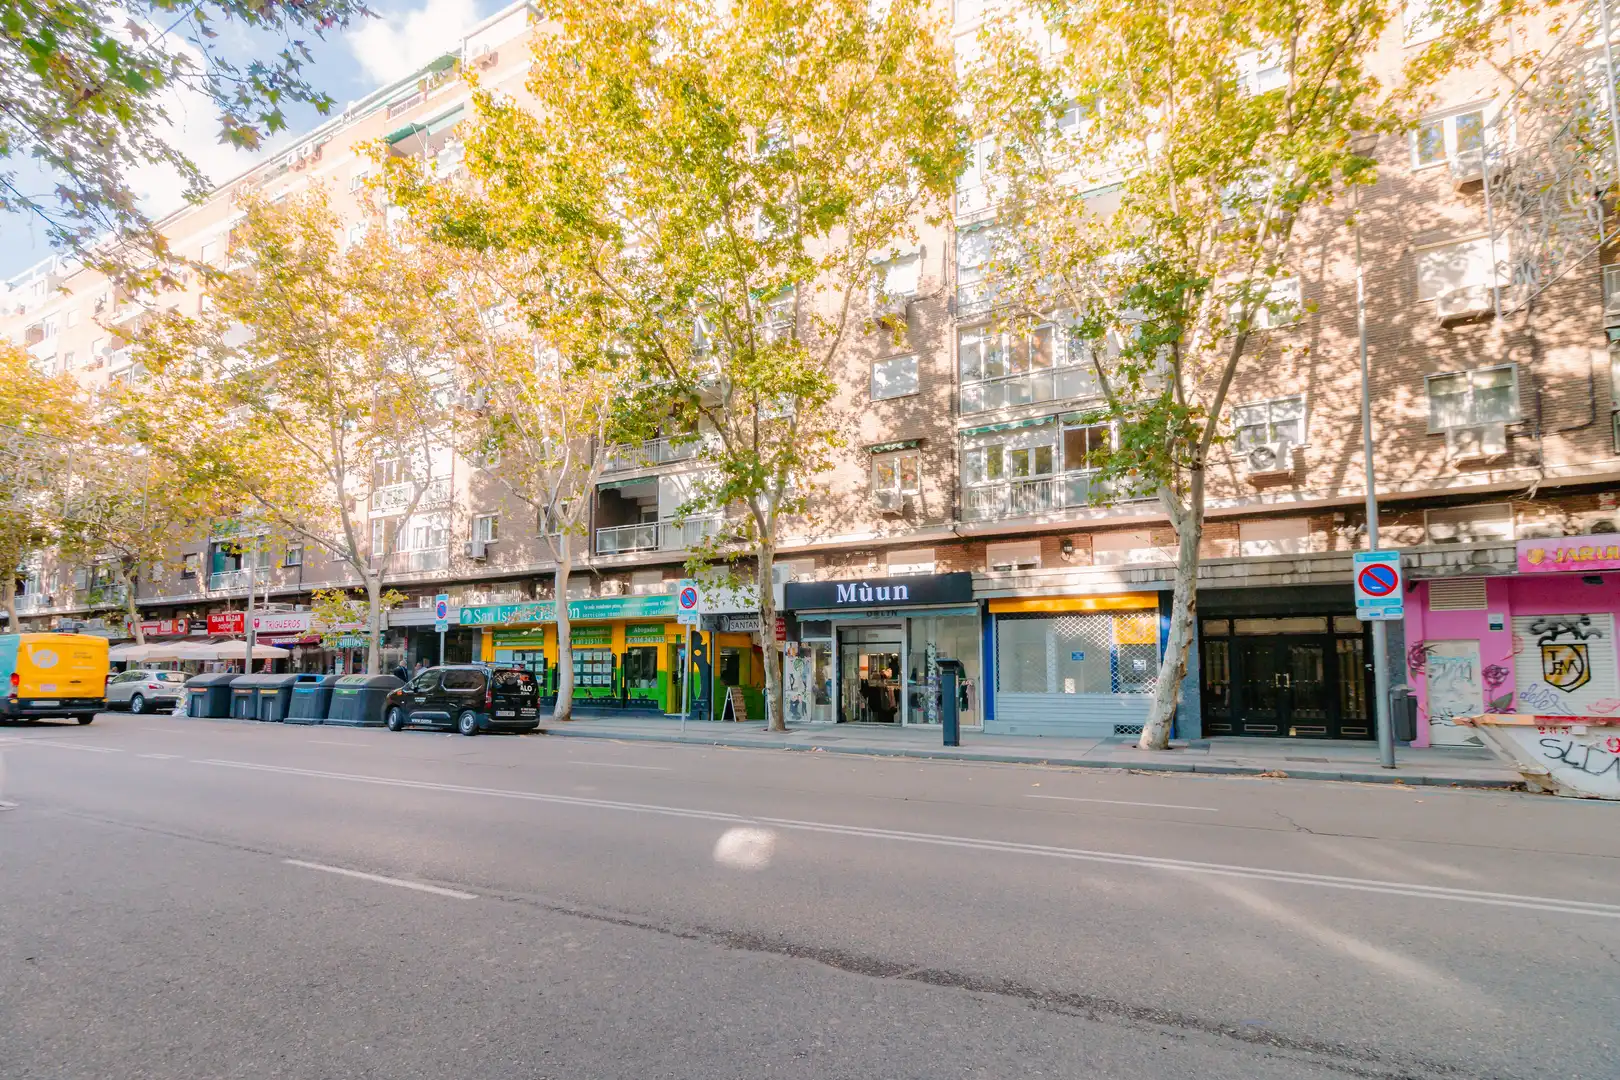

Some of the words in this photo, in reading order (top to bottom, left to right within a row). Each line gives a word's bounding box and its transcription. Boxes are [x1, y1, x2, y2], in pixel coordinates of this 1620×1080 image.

[836, 582, 909, 603] Mùun
[211, 615, 225, 623] GRAN
[473, 608, 494, 624] San
[265, 620, 301, 629] TRIGUEROS
[730, 620, 759, 630] SANTAN
